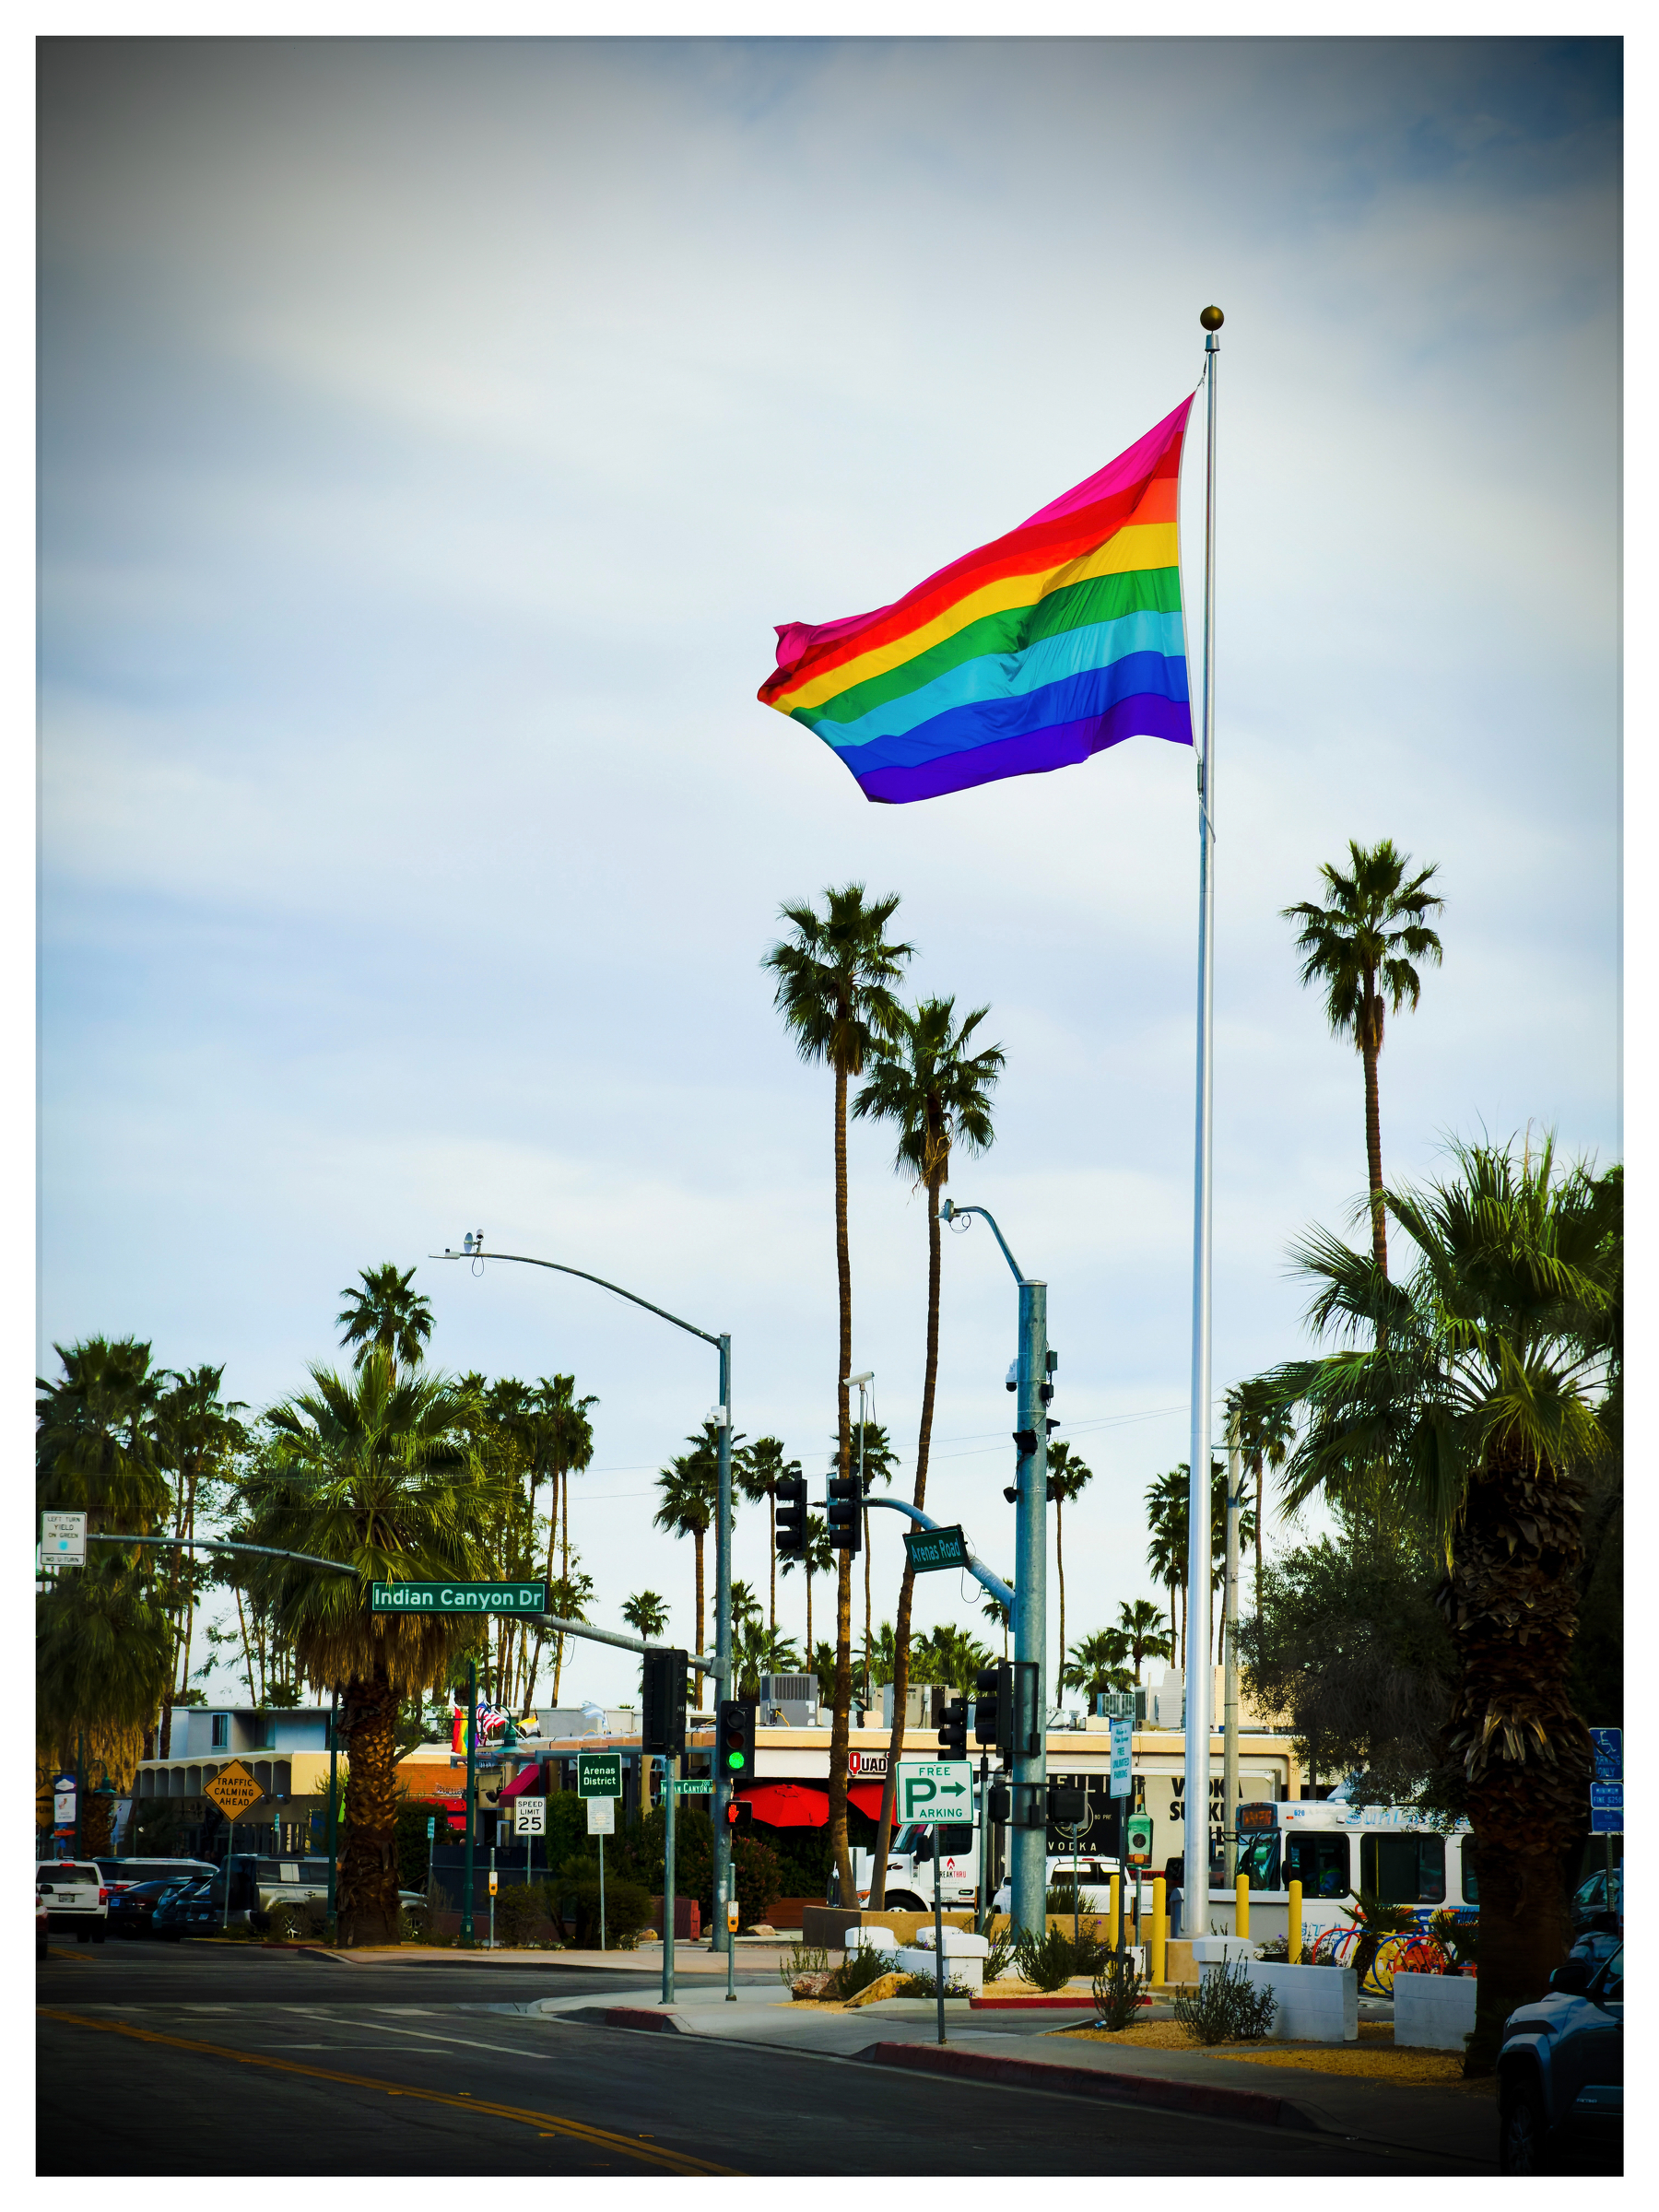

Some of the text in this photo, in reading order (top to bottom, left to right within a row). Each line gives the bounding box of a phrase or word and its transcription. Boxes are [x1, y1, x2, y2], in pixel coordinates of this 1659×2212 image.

[911, 1537, 961, 1562] Arenas Road
[375, 1588, 542, 1610] Indian Canyon Dr
[583, 1766, 616, 1775] Arenas
[919, 1767, 951, 1776] FREE
[217, 1777, 253, 1786] TRAFFIC
[583, 1777, 617, 1785] District
[214, 1788, 253, 1796] CALMING
[219, 1797, 250, 1806] AHEAD
[518, 1817, 542, 1830] 25
[1048, 1841, 1097, 1852] VODKA
